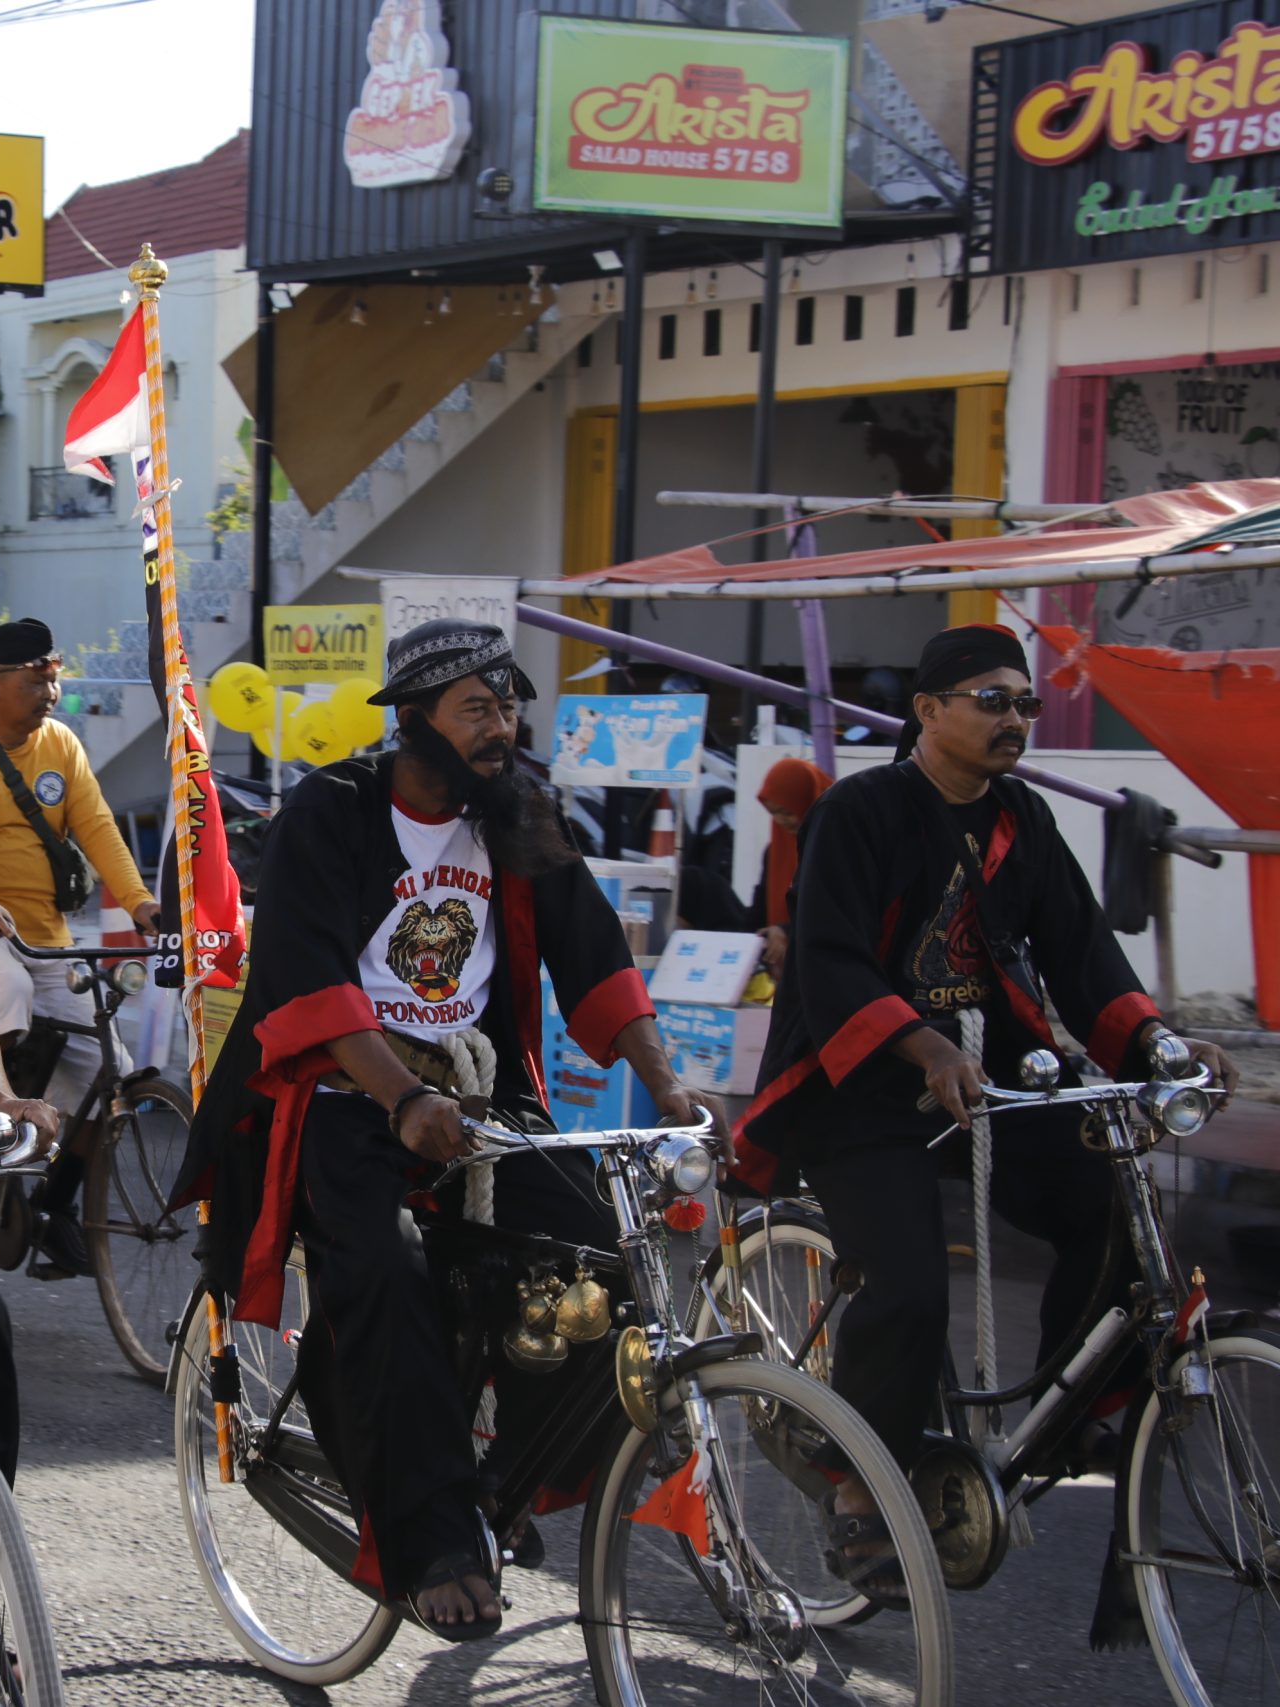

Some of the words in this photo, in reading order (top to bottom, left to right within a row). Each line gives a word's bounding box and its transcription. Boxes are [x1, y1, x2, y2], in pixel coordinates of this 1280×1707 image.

[1191, 110, 1280, 159] 5758
[580, 145, 640, 165] SALAD
[644, 149, 709, 170] HOUSE
[714, 149, 790, 175] 5758
[1177, 404, 1247, 434] FRUIT
[270, 612, 368, 654] maxim
